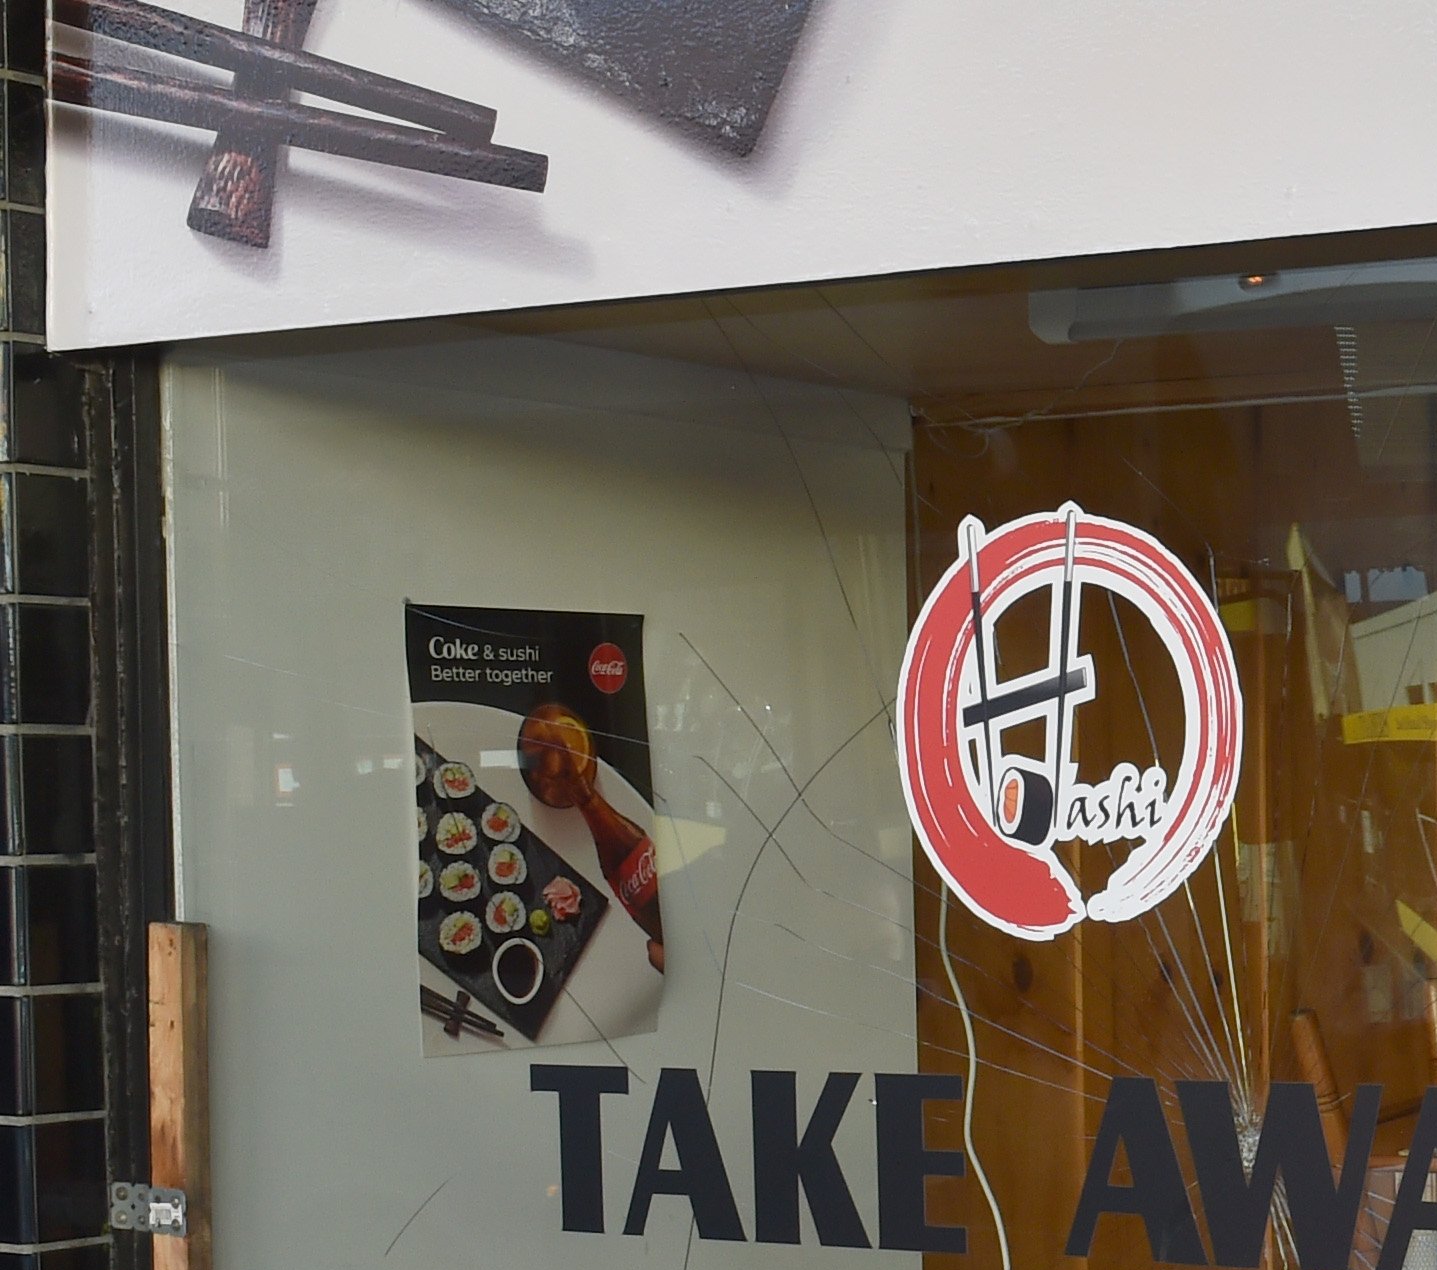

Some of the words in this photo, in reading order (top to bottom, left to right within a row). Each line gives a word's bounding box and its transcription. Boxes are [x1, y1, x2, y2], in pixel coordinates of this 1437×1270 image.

[429, 636, 479, 660] Coke
[484, 646, 495, 660] &
[499, 645, 539, 662] sushi
[431, 666, 481, 682] Better
[486, 667, 553, 685] together
[530, 1063, 967, 1256] TAKE
